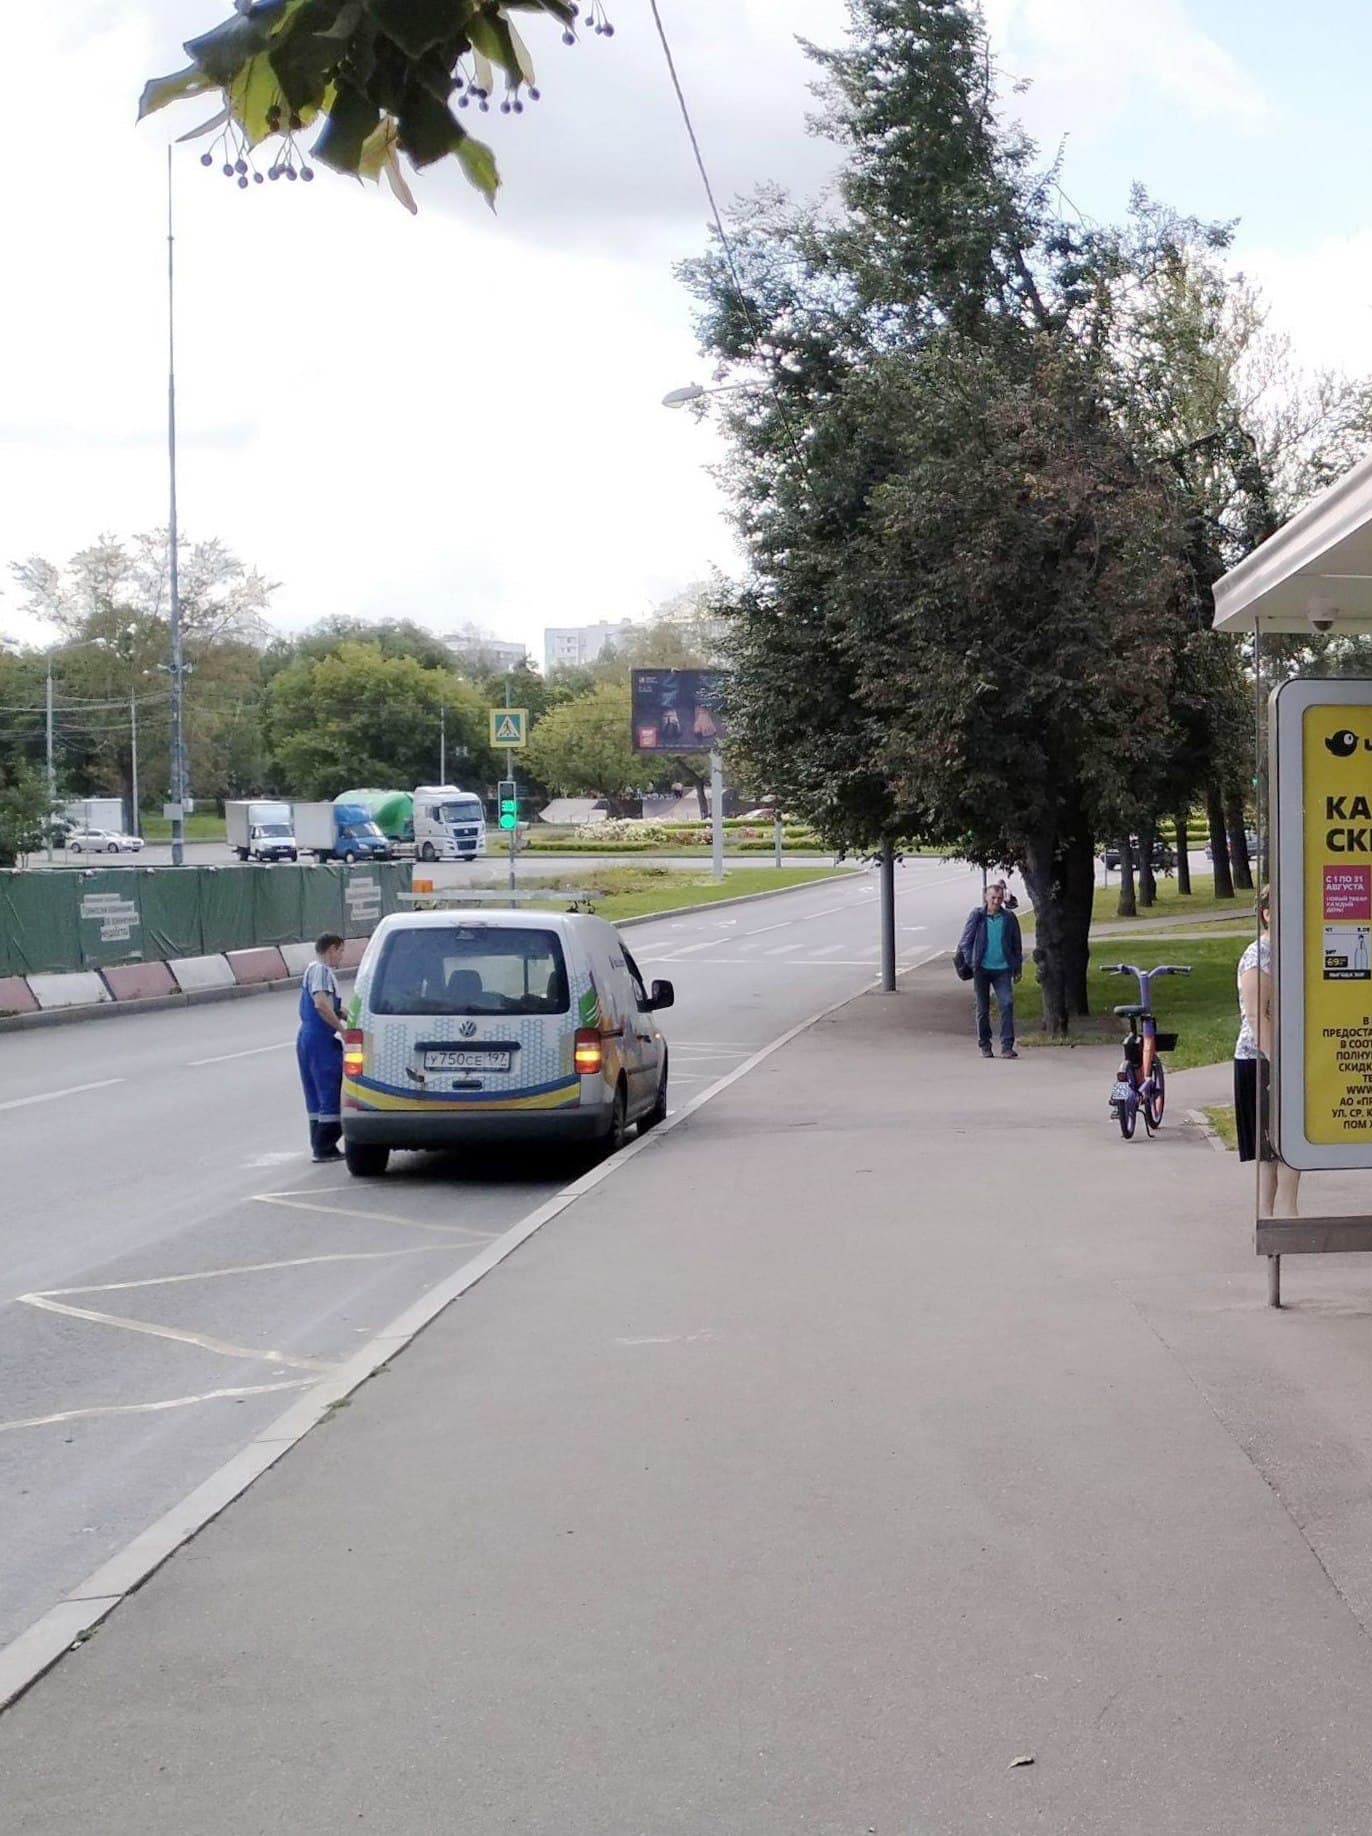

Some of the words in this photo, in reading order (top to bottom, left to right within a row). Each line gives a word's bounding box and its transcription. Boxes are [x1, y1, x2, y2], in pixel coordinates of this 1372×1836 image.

[1326, 883, 1364, 891] АВГУСТА
[1363, 1017, 1369, 1025] В
[1340, 1039, 1347, 1048] В
[488, 1051, 506, 1061] 197
[1340, 1097, 1354, 1106] АО
[1331, 1109, 1347, 1118] УЛ.
[1349, 1108, 1364, 1117] СР.
[1343, 1120, 1367, 1129] ПОМ
